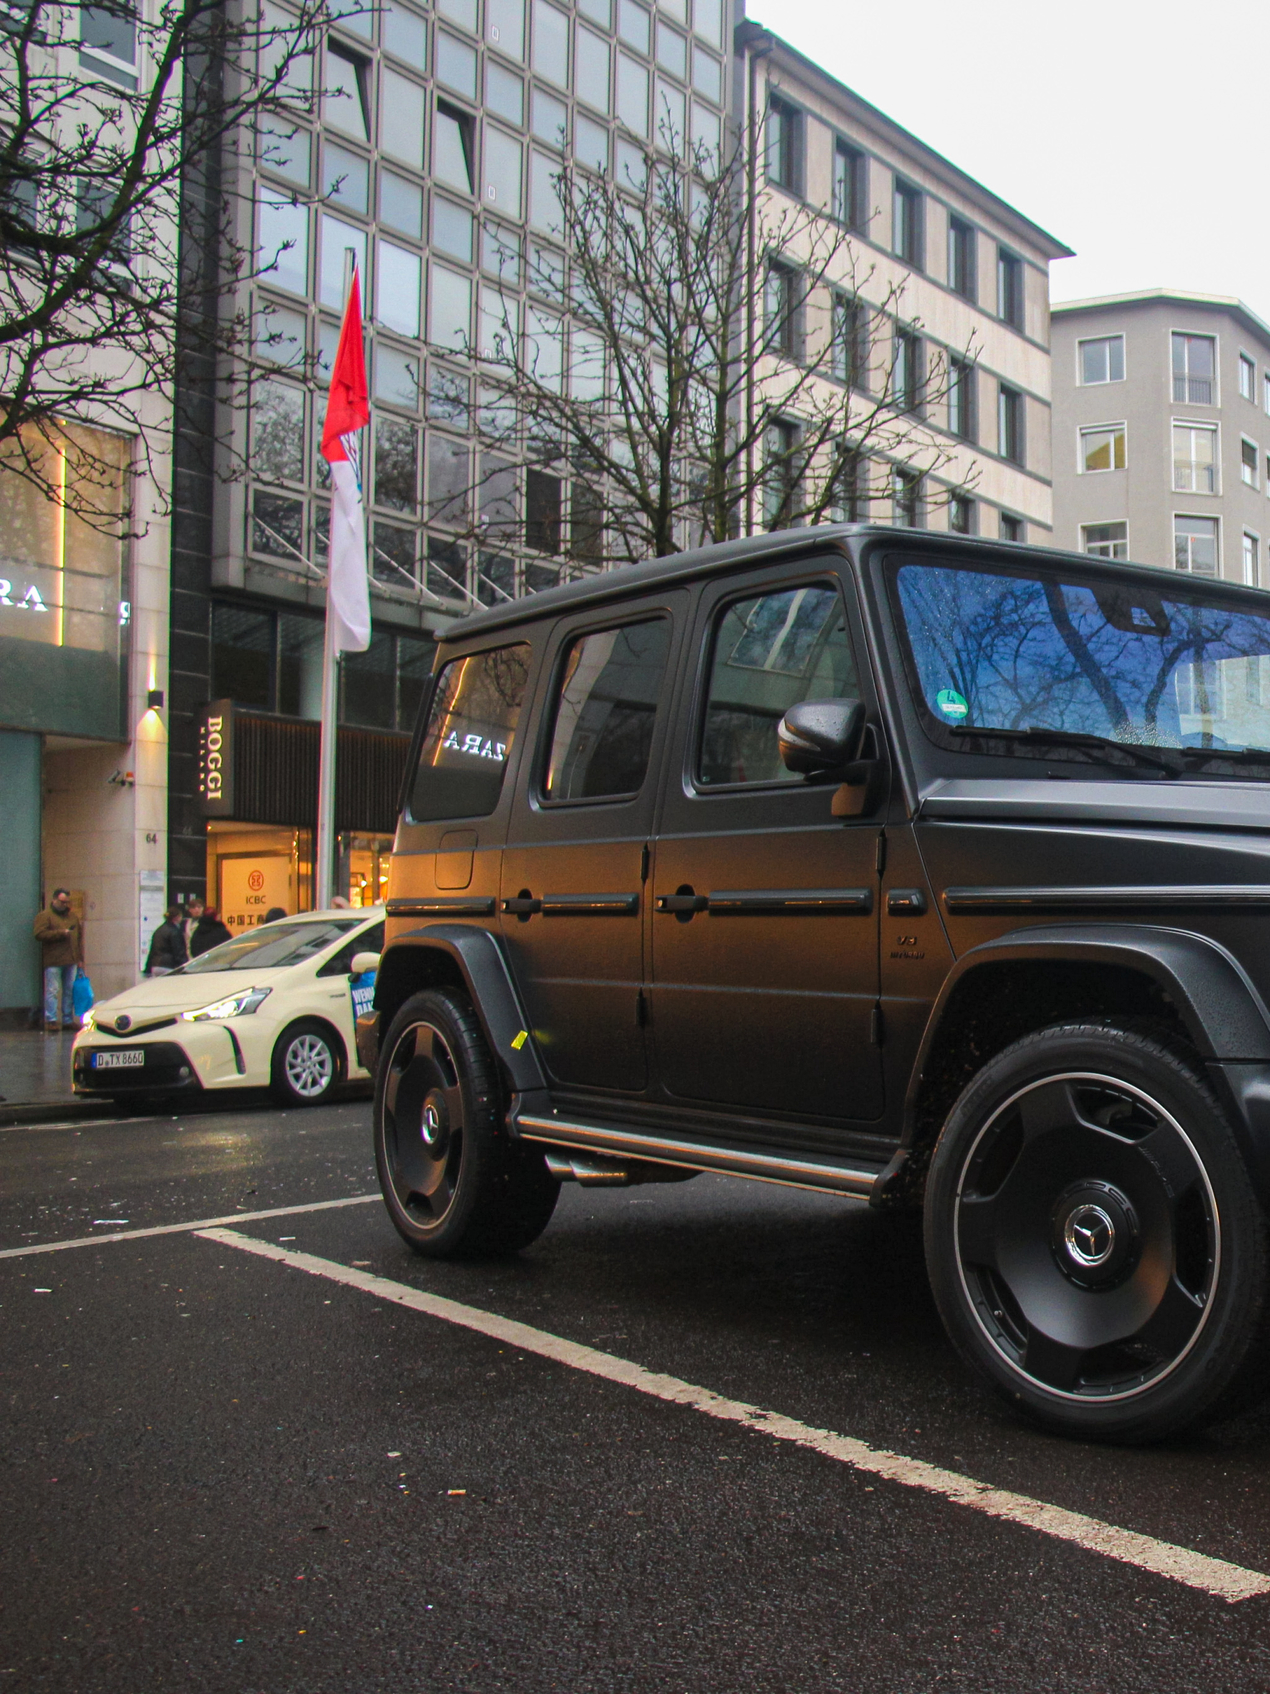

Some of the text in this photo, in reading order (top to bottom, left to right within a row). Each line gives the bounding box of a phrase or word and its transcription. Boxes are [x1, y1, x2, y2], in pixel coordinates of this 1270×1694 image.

[207, 716, 223, 800] BOGGI
[146, 833, 157, 844] 64
[245, 895, 266, 904] ICBC
[122, 1052, 144, 1064] 8660
